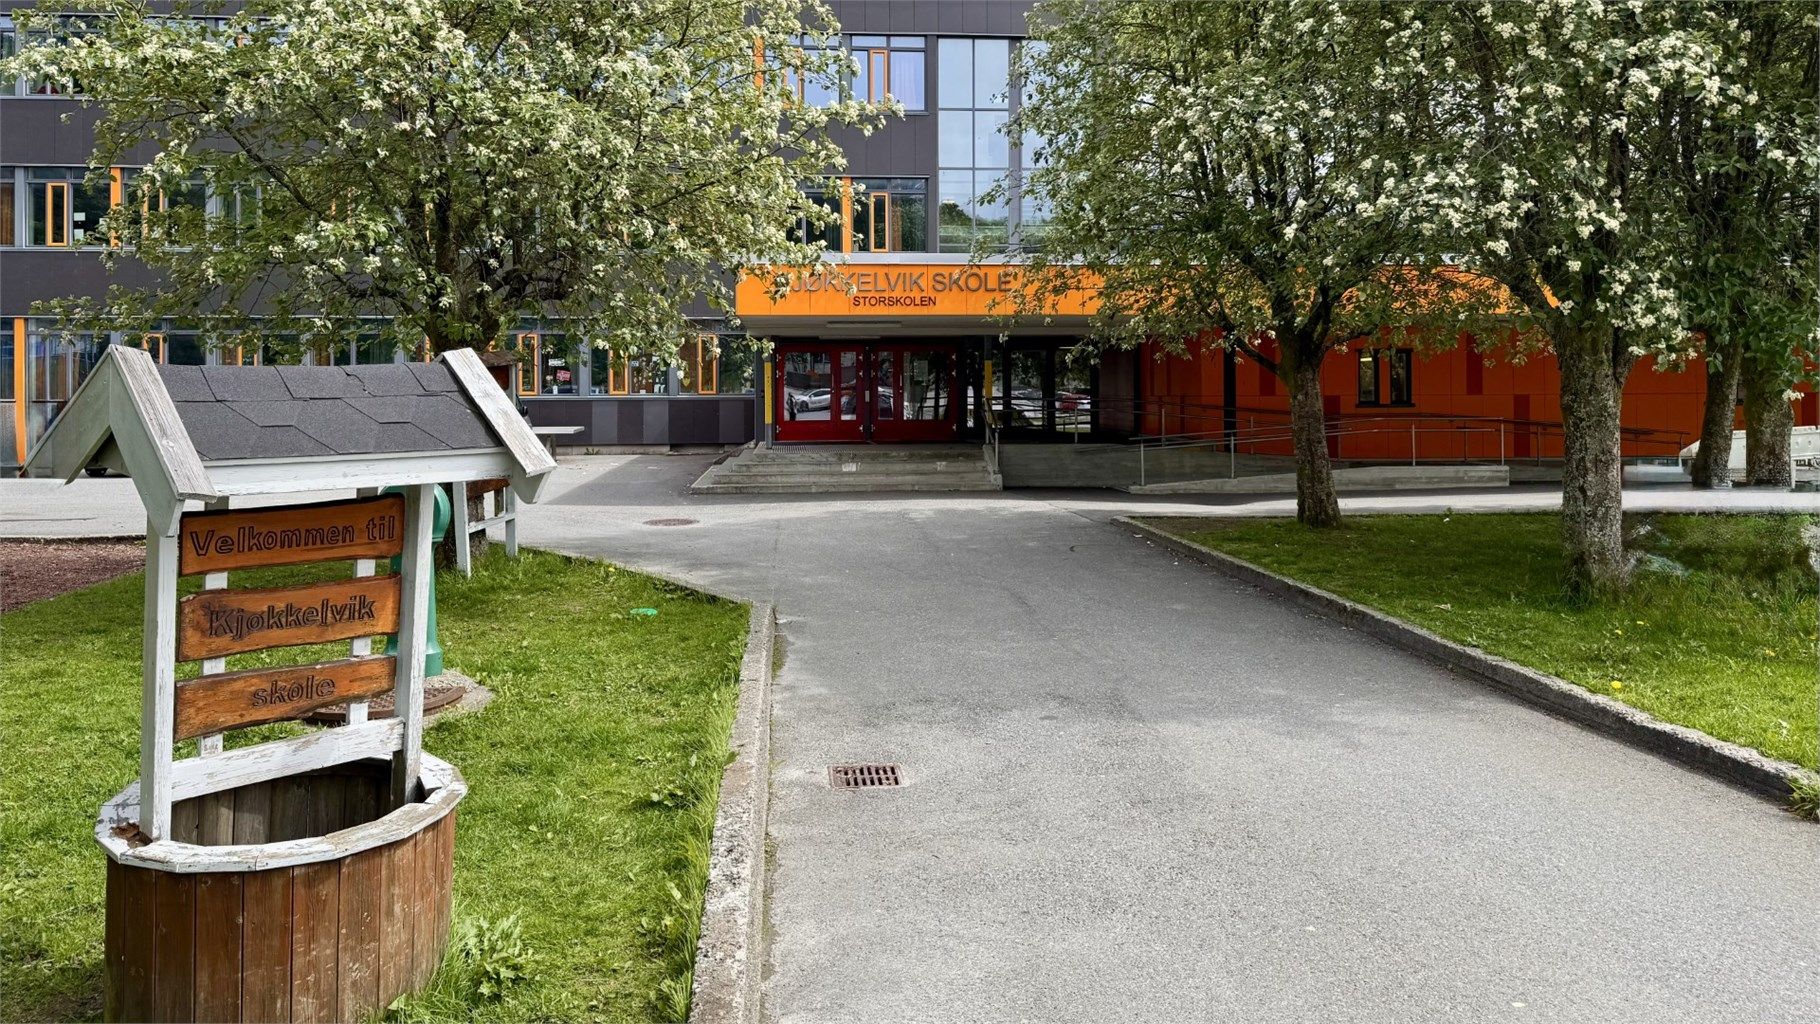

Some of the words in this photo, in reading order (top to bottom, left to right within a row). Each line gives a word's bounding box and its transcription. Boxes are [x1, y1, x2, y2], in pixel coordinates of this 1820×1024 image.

[932, 272, 1012, 292] SKOLE
[852, 296, 937, 307] STORSKOLEN
[190, 524, 355, 557] Velkommen
[366, 515, 396, 542] til
[252, 675, 336, 708] skole
